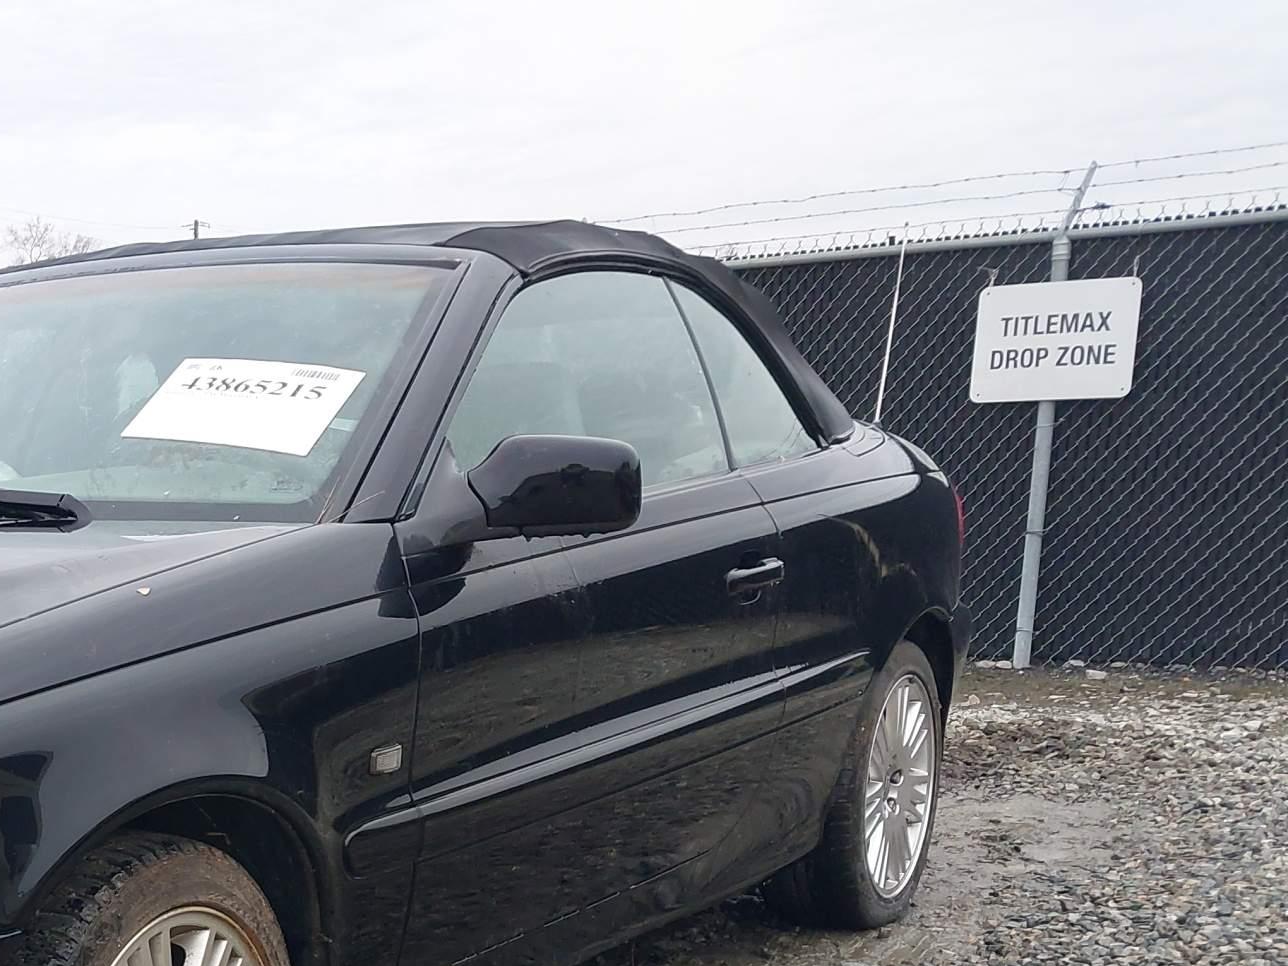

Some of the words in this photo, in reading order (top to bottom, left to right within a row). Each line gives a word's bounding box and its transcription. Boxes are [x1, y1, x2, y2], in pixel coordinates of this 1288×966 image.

[1000, 310, 1112, 337] TITLEMAX
[990, 347, 1048, 370] DROP
[1055, 344, 1117, 367] ZONE
[180, 376, 328, 400] 43865215
